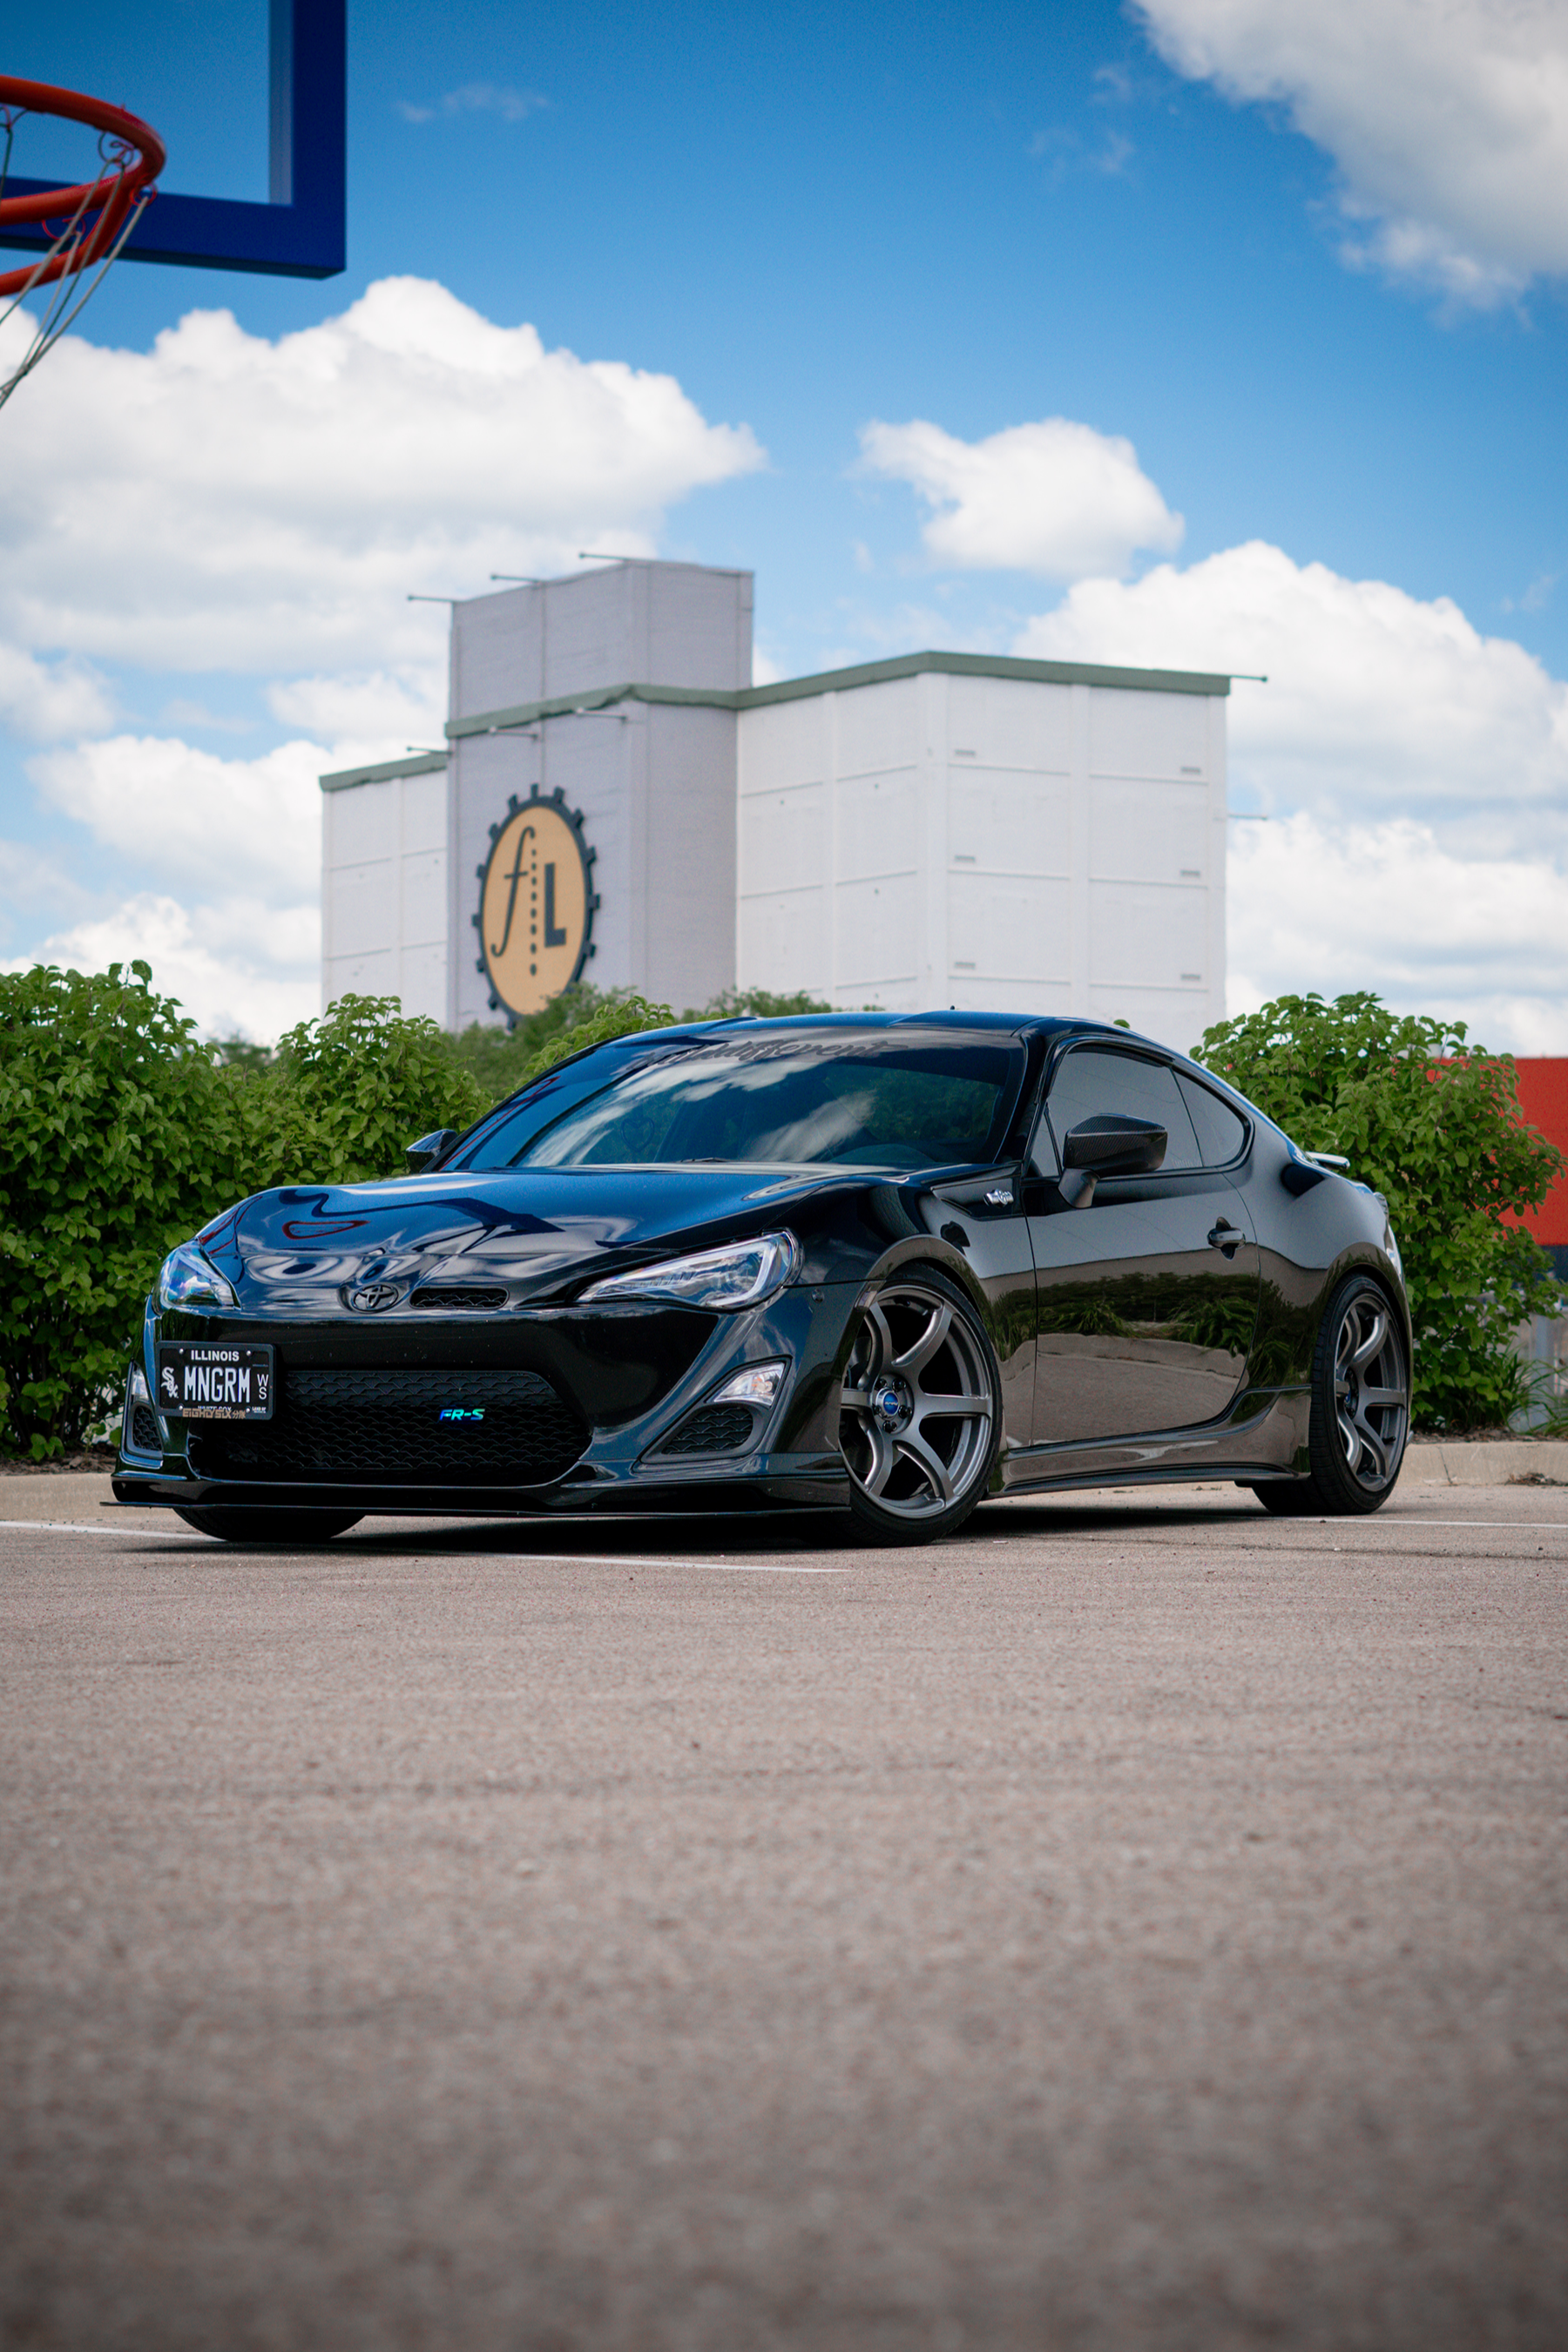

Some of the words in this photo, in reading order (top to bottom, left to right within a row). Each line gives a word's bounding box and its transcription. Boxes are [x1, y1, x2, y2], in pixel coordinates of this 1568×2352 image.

[191, 1349, 240, 1362] ILLINOIS
[184, 1366, 251, 1402] MNGRM
[439, 1409, 485, 1421] FR-S
